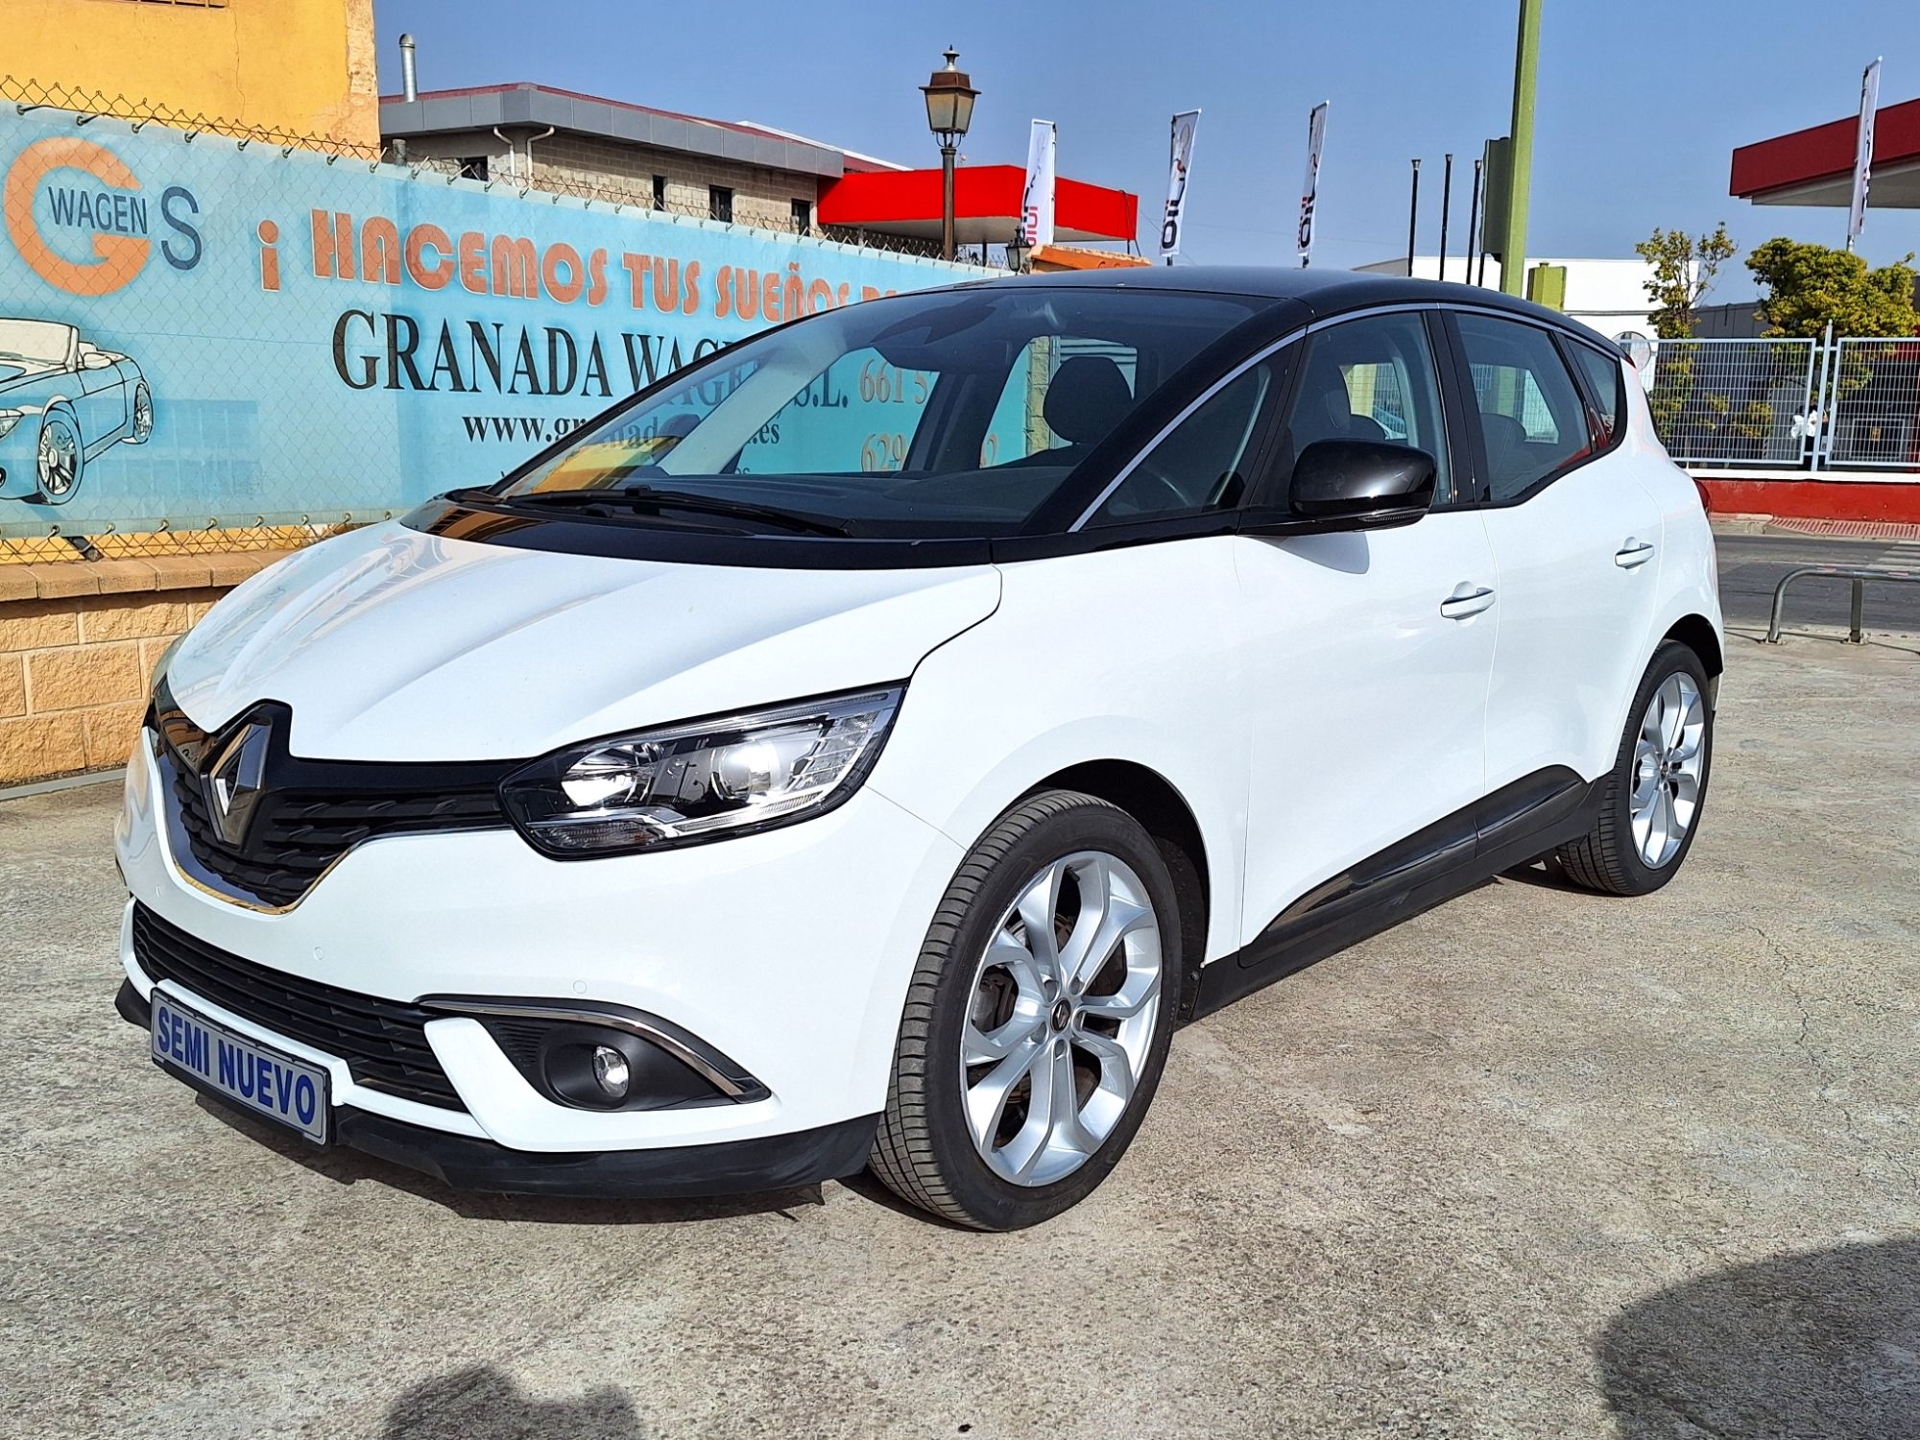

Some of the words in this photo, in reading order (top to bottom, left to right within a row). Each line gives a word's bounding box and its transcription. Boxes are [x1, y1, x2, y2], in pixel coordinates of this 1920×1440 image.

[48, 185, 148, 235] WAGEN
[160, 185, 202, 271] S
[311, 208, 609, 307] HACEMOS
[621, 251, 701, 316] TUS
[332, 309, 614, 398] GRANADA
[859, 358, 904, 404] 661
[158, 1005, 211, 1078] SEMI
[218, 1039, 316, 1126] NUEVO
